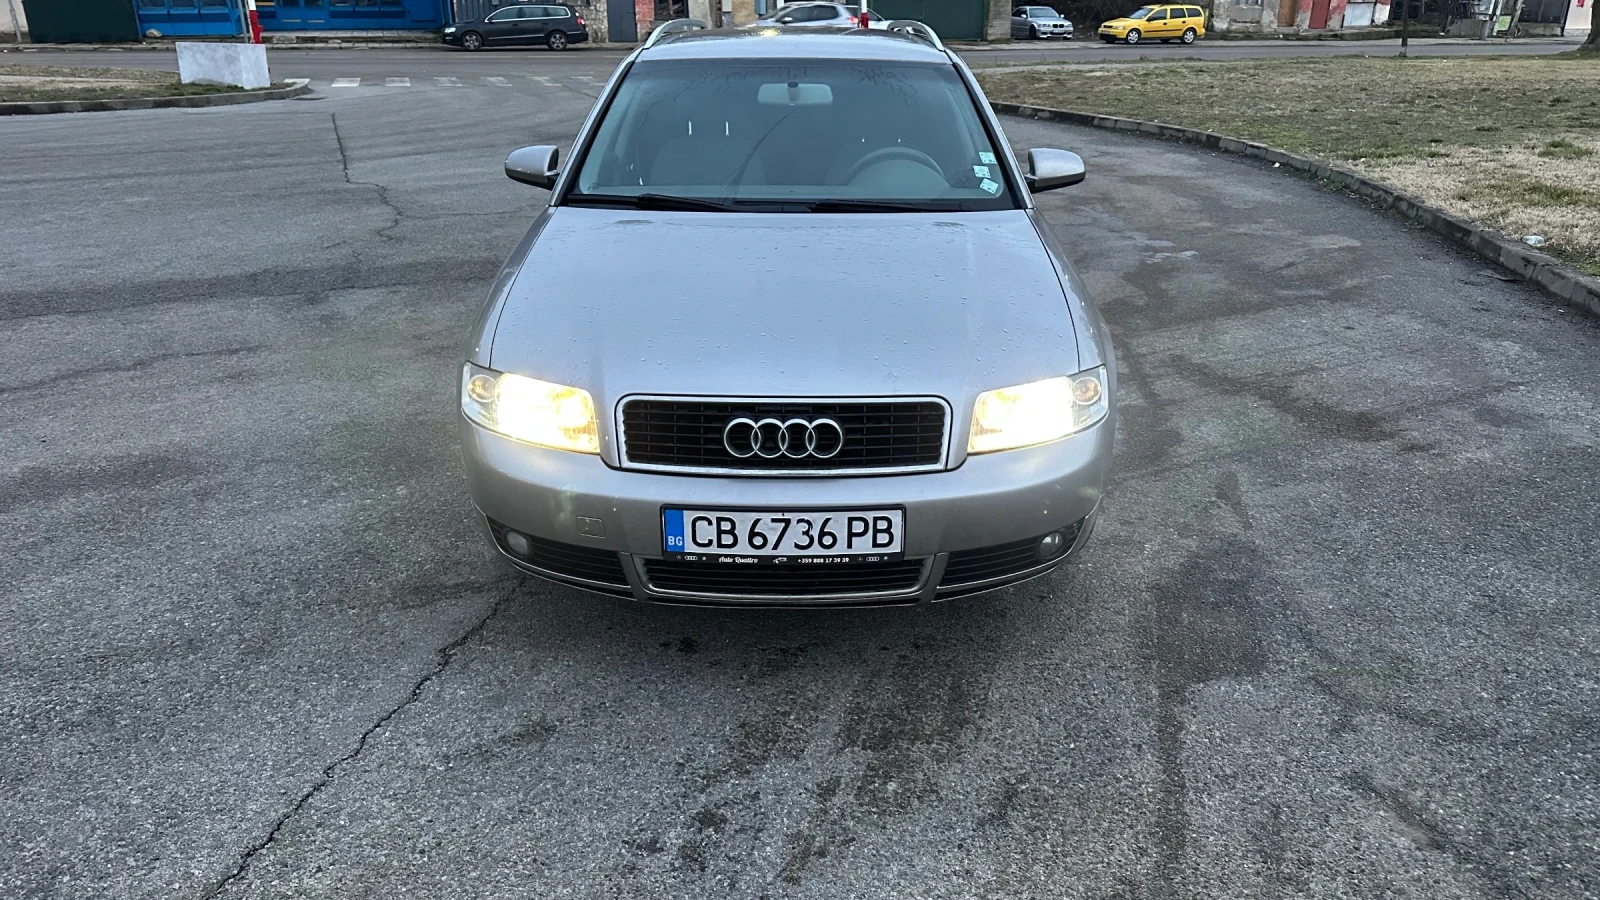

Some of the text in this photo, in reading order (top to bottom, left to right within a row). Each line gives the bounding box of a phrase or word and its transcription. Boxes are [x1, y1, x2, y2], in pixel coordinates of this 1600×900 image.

[668, 535, 683, 546] BG
[691, 516, 894, 551] CB 6736 PB
